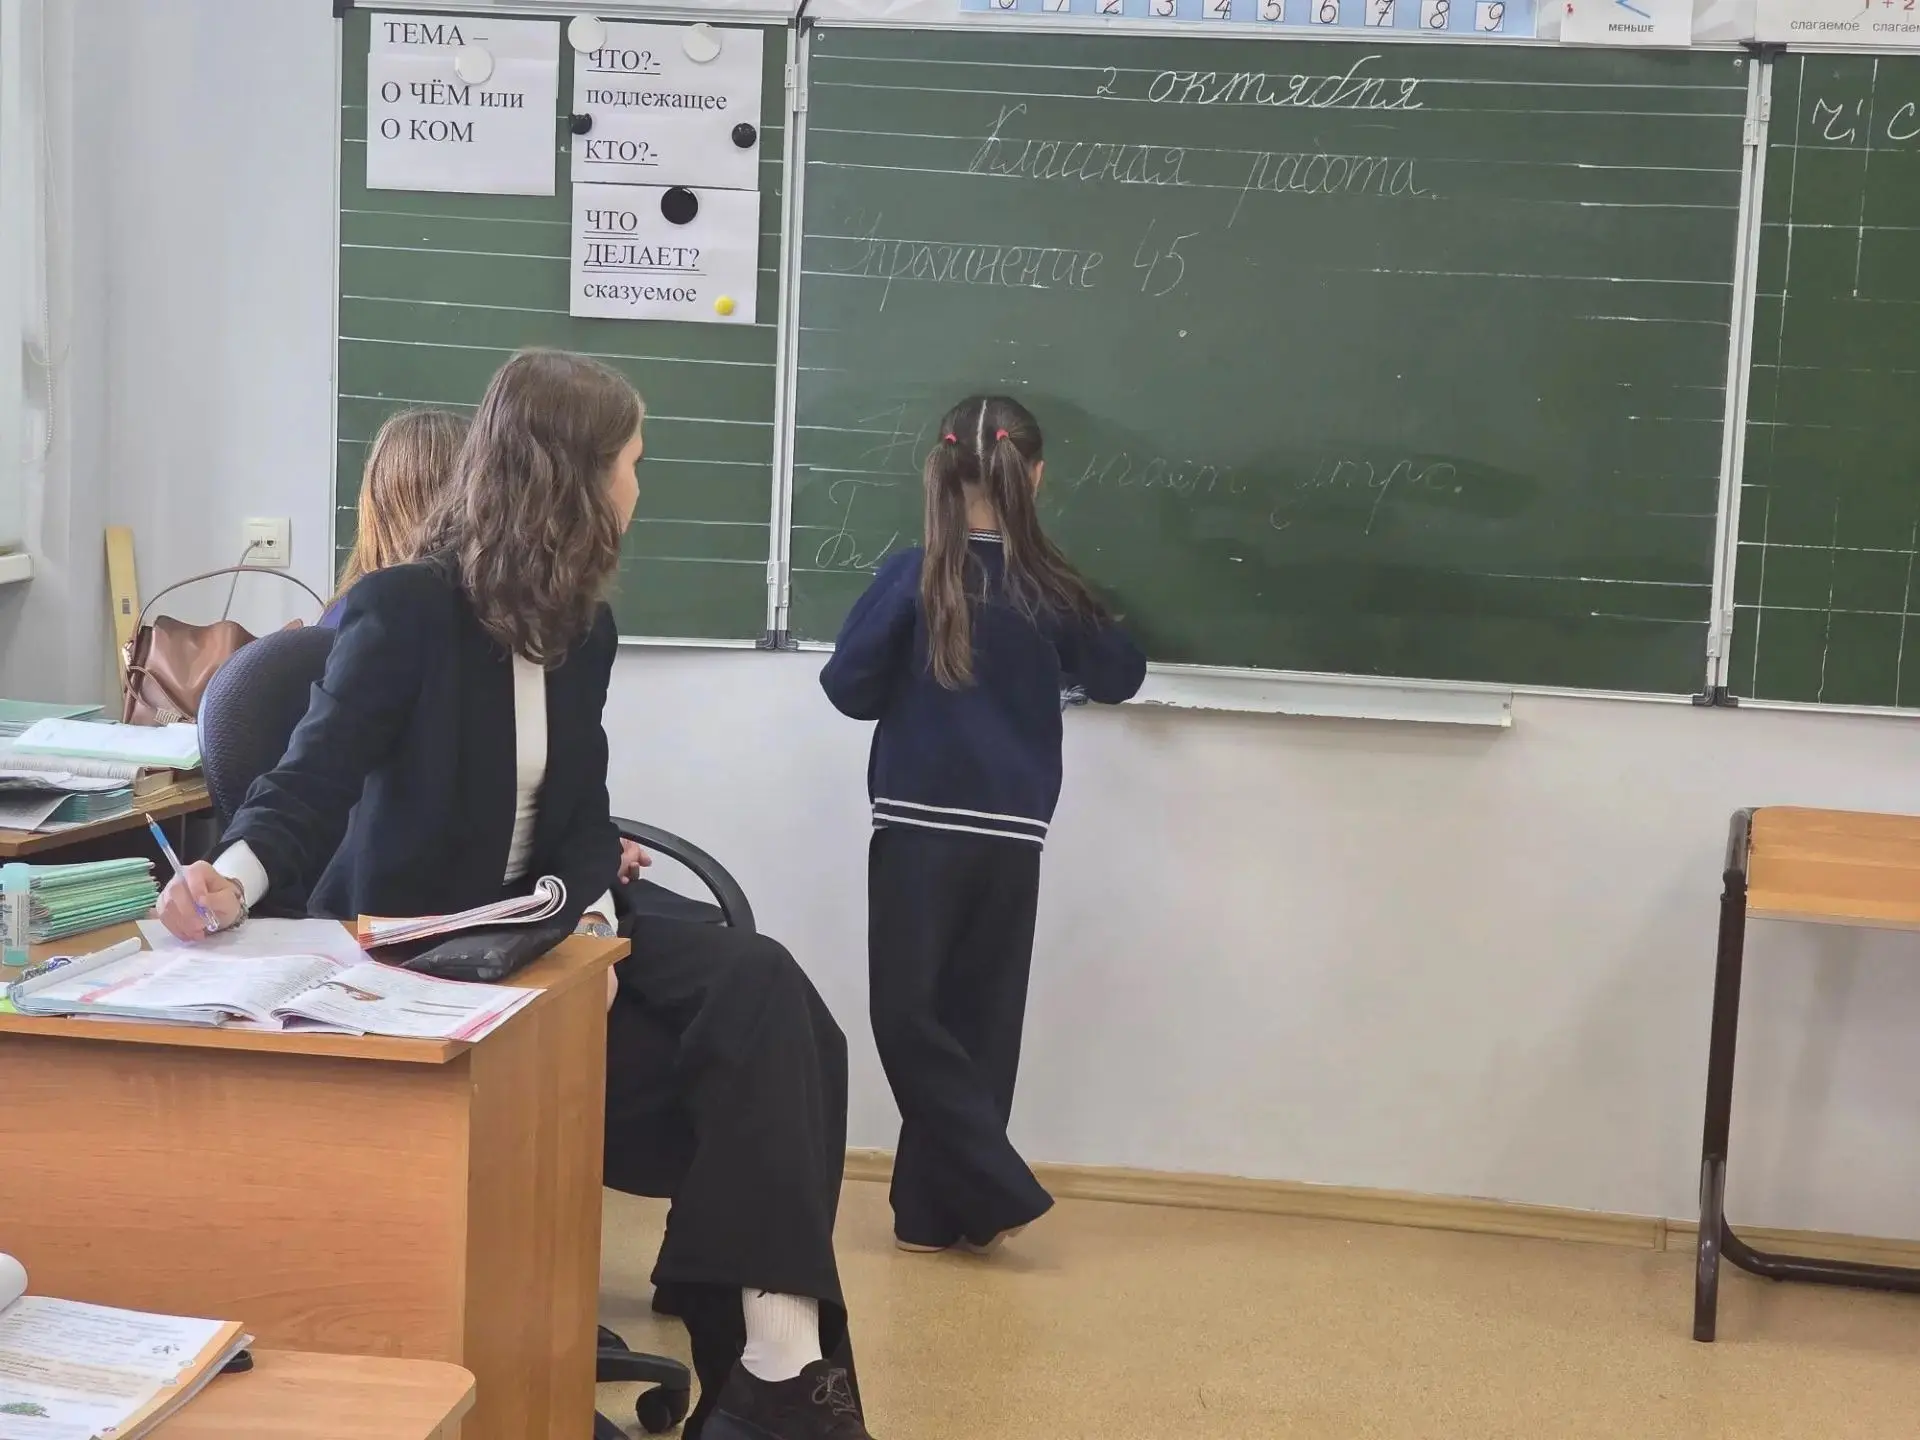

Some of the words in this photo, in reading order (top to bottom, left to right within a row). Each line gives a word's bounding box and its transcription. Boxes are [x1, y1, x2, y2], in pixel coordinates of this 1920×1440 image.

[1262, 0, 1282, 21] 5
[1319, 0, 1337, 24] 6
[1374, 0, 1394, 27] 7
[1429, 0, 1449, 29] 8
[1484, 2, 1505, 32] 9
[1608, 22, 1654, 33] меньше
[1790, 20, 1860, 32] слагаемое
[383, 21, 466, 46] ТЕМА
[1096, 66, 1118, 96] 2
[381, 81, 400, 103] О
[409, 79, 471, 106] ЧЁМ
[480, 91, 524, 109] или
[586, 88, 728, 112] подлежащее
[381, 118, 400, 140] О
[409, 119, 474, 143] КОМ
[584, 138, 658, 162] КТО?-
[969, 103, 1193, 187] Классная
[585, 209, 637, 231] ЧТО
[584, 243, 700, 270] ДЕЛАЕТ?
[583, 282, 697, 303] сказуемое
